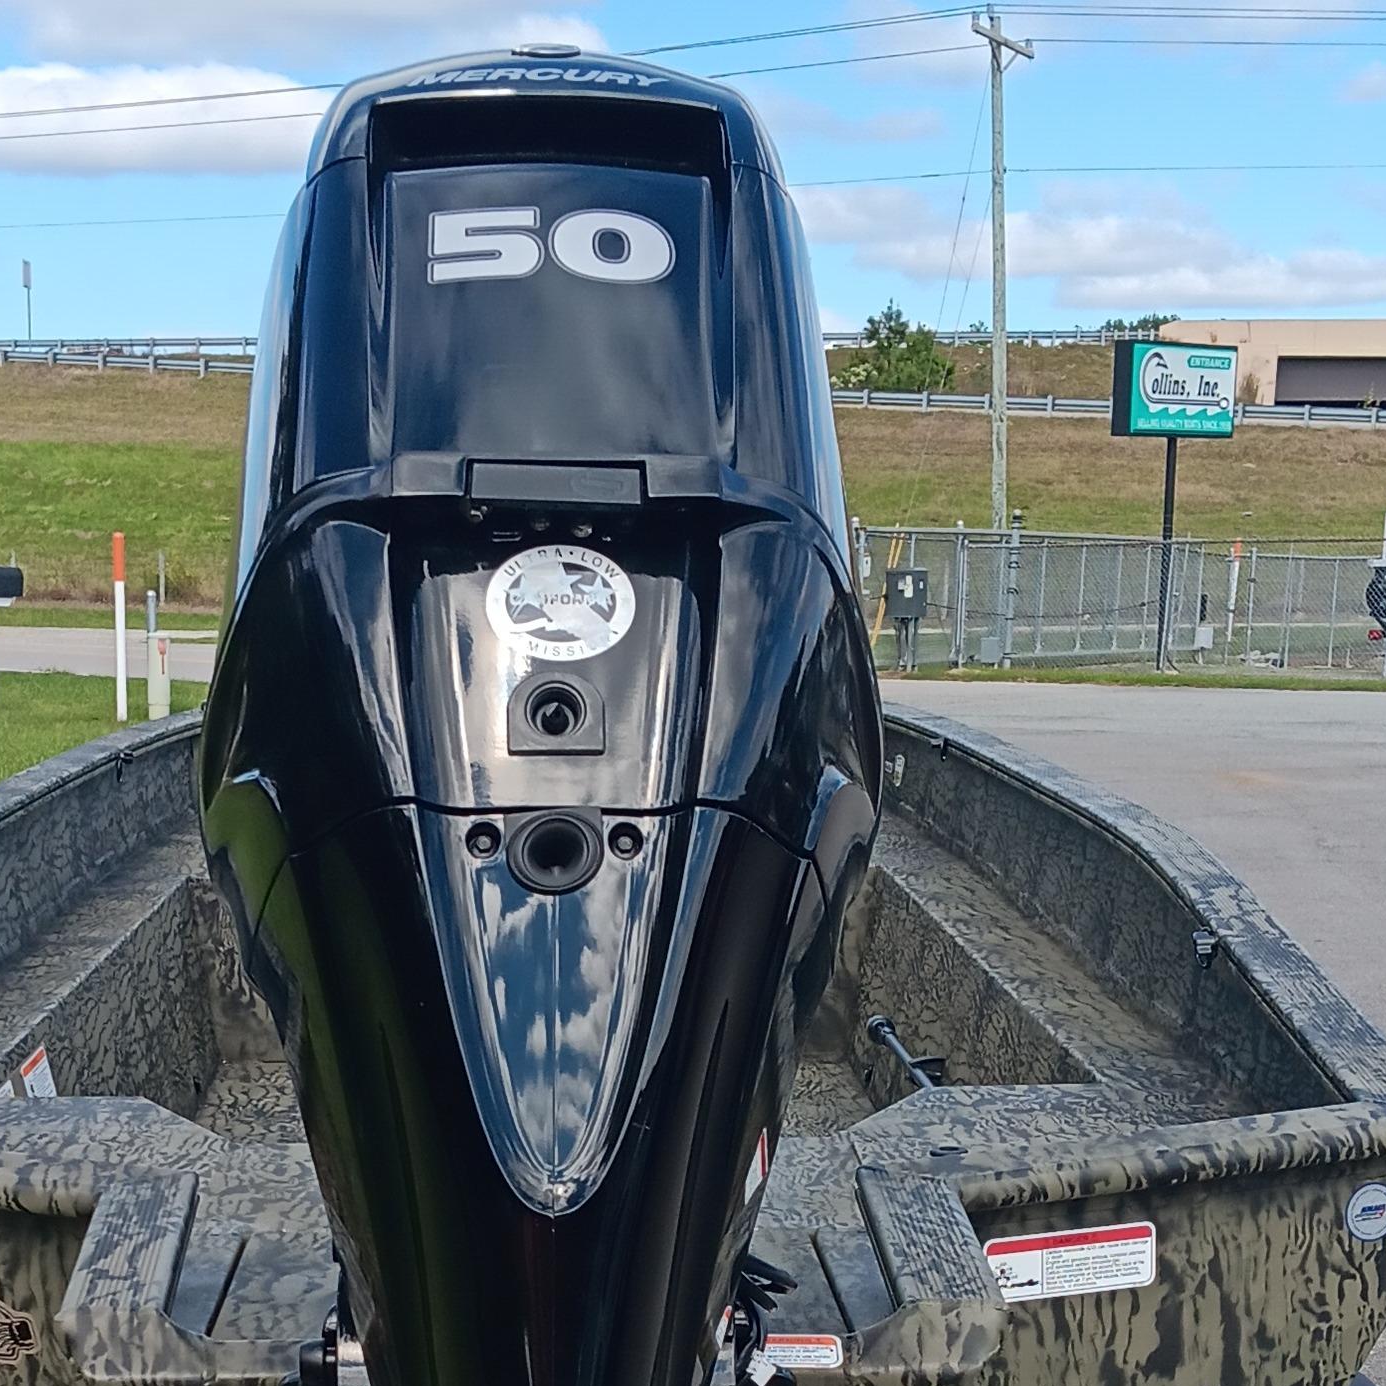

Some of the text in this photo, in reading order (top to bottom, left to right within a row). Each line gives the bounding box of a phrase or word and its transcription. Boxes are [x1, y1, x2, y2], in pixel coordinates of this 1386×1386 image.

[406, 67, 669, 87] MERCURY
[427, 206, 677, 285] 50
[1189, 357, 1229, 368] ENTRANCE
[1197, 375, 1220, 398] Inc.
[580, 551, 621, 579] LOW
